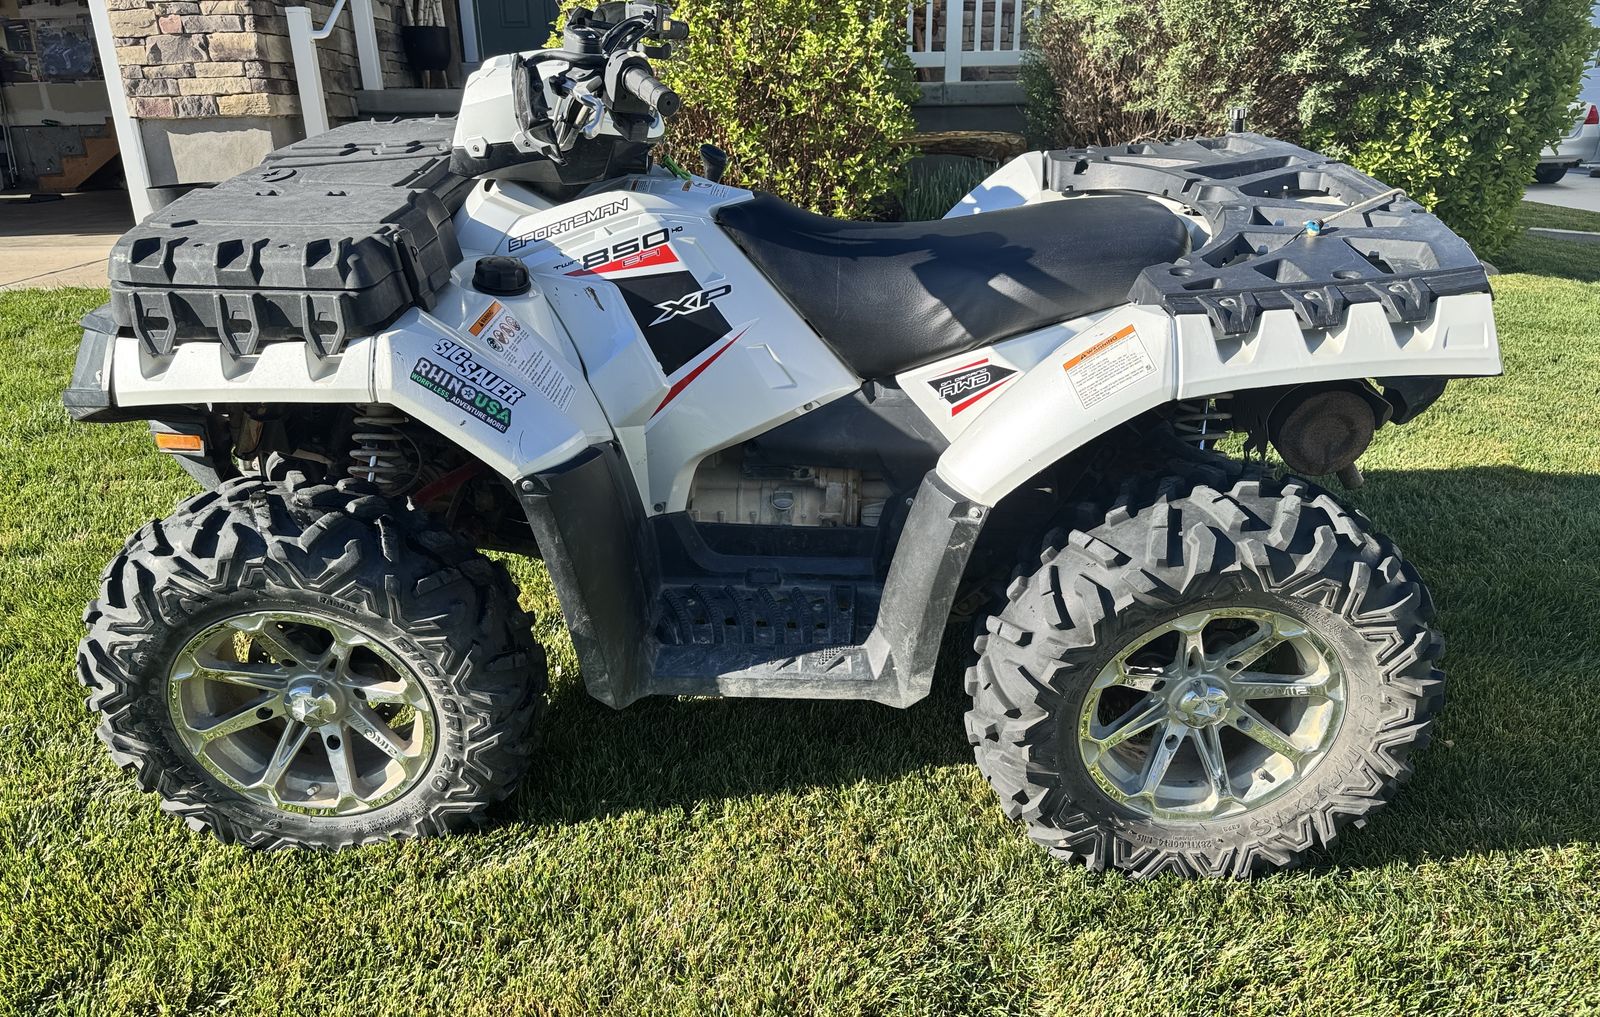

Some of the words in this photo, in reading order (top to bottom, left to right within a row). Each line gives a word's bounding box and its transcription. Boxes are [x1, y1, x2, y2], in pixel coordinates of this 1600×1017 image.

[507, 197, 629, 252] SPORTSMAN
[582, 227, 670, 270] 850
[622, 248, 661, 268] EFI
[648, 284, 732, 327] XP
[411, 372, 433, 389] WORRY
[450, 396, 486, 422] ADVENTURE
[486, 416, 507, 431] MORE!
[415, 358, 476, 400] RHINO
[474, 391, 512, 425] USA
[939, 371, 991, 400] AWD
